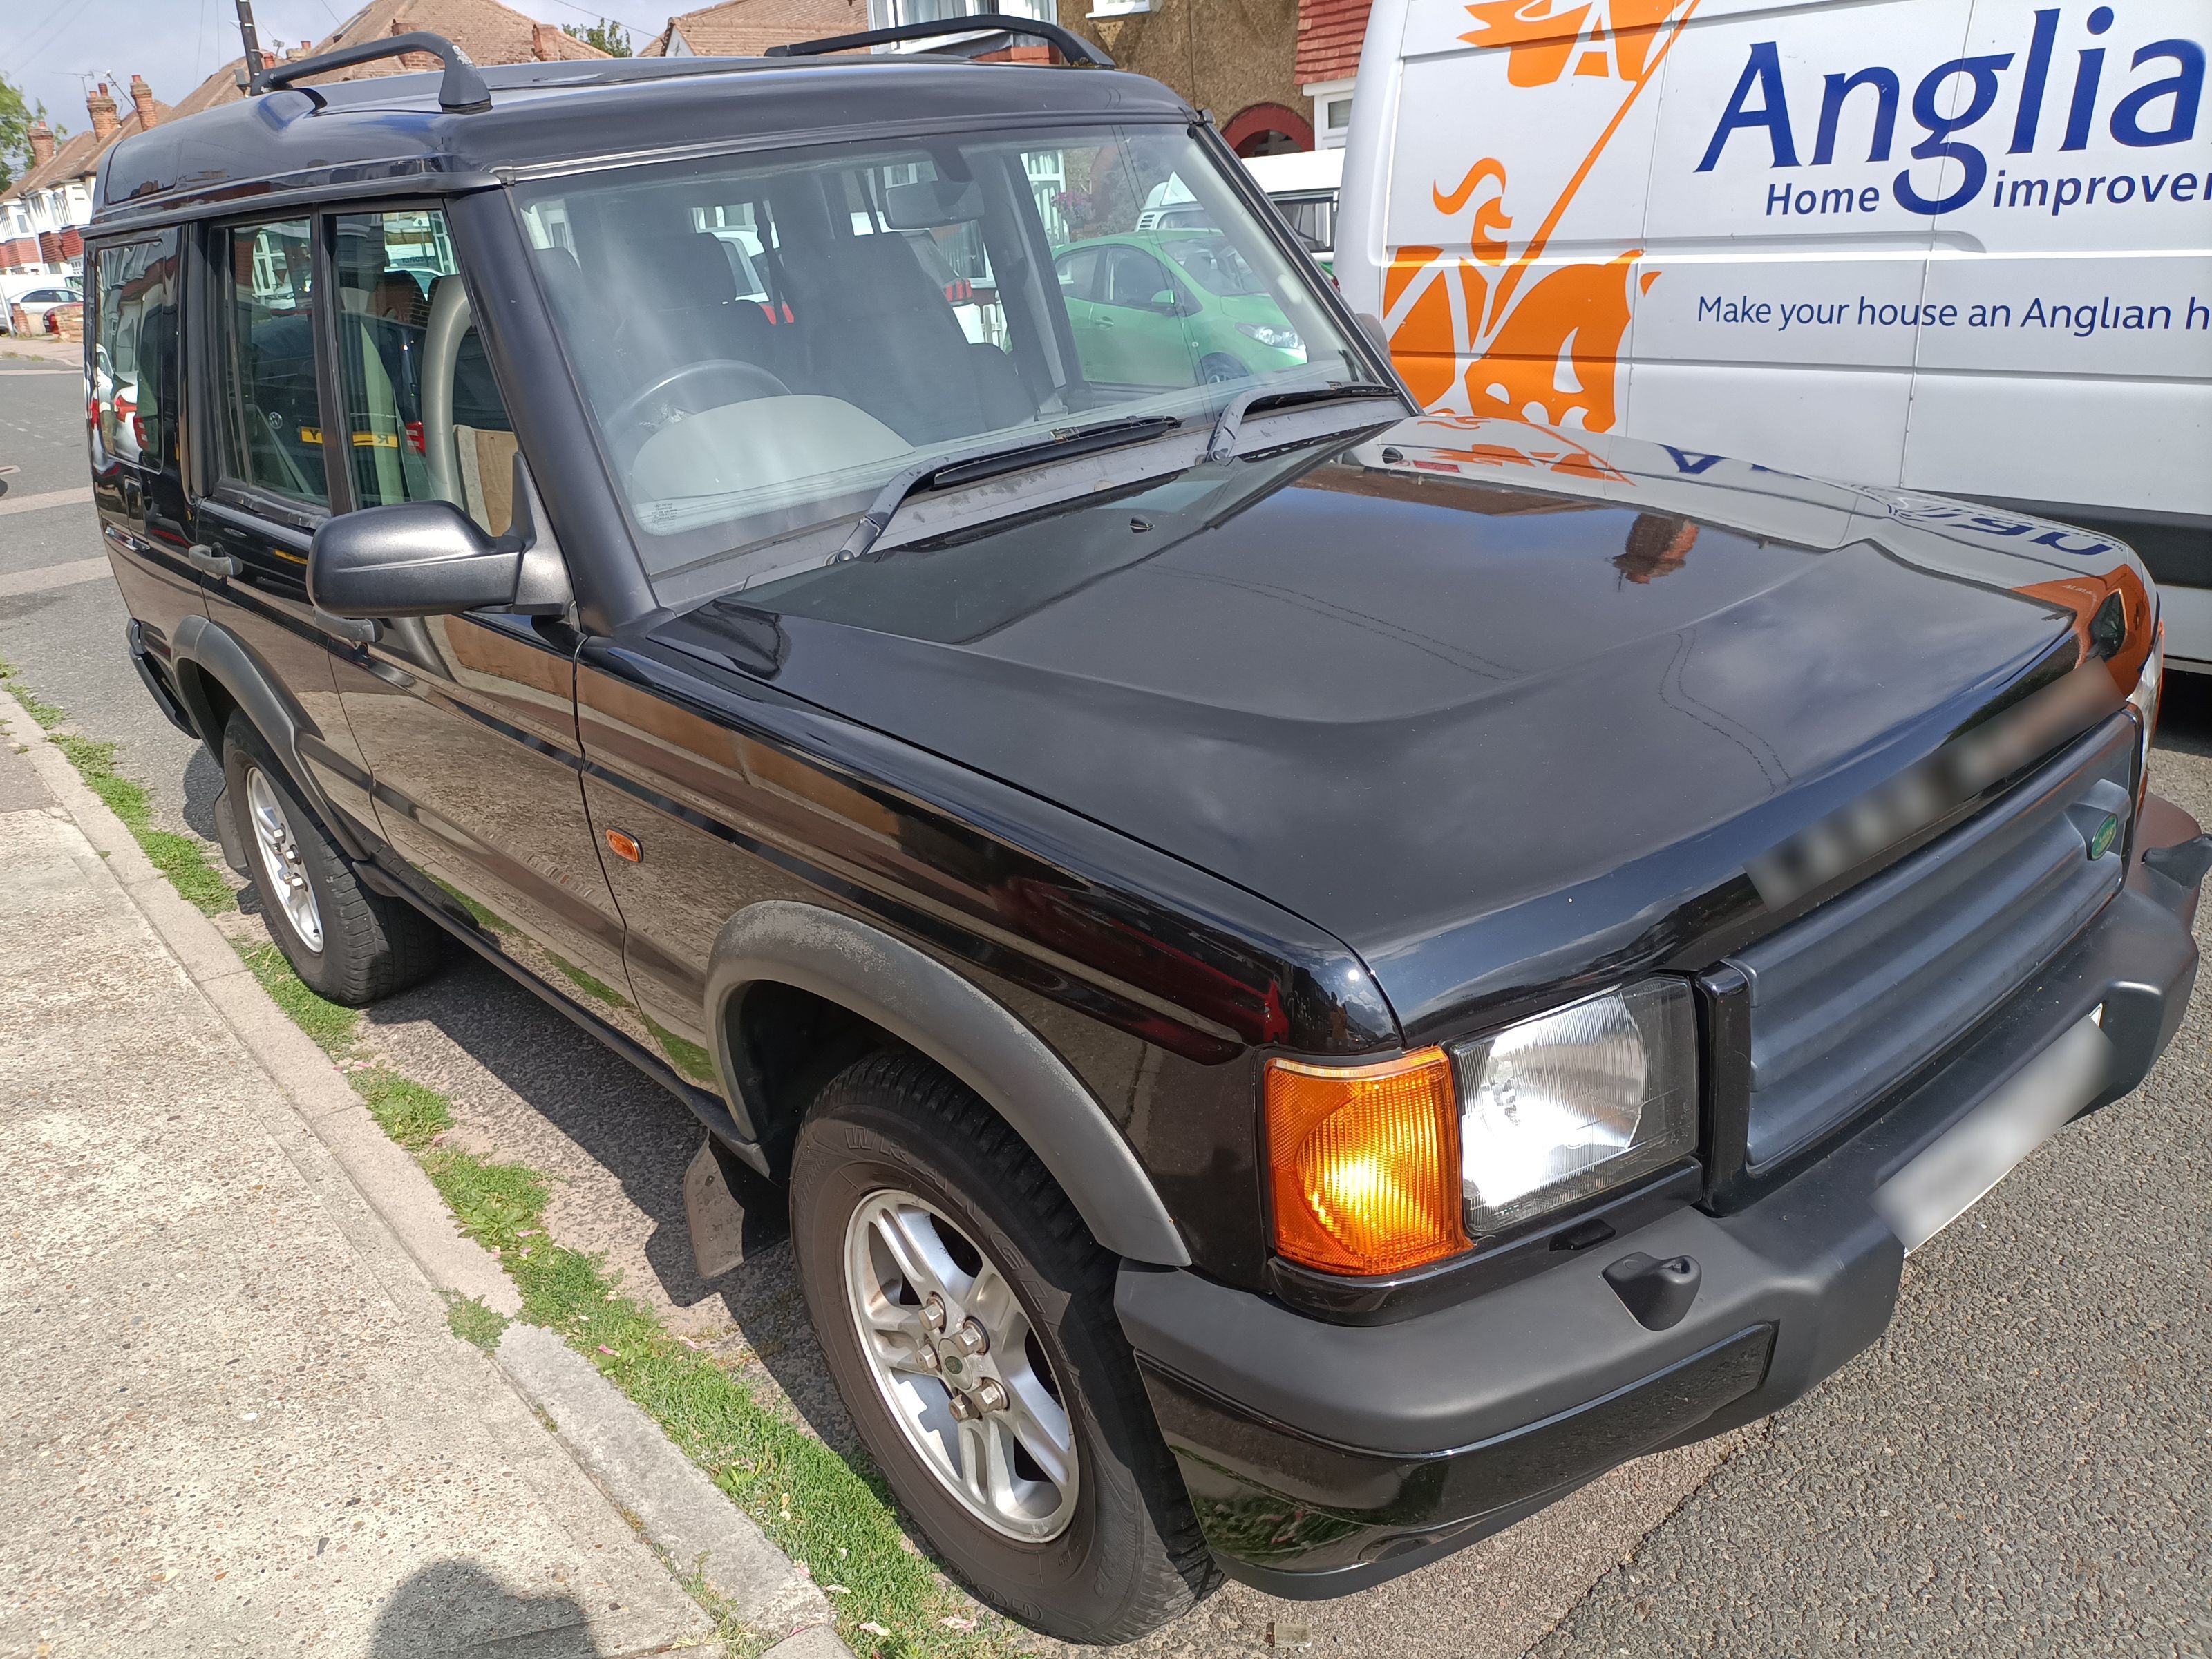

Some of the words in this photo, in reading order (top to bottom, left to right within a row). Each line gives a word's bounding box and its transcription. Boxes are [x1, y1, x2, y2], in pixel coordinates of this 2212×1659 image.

[1693, 6, 2206, 216] Anglia
[1765, 182, 1880, 216] Home
[1992, 169, 2212, 216] improve
[1697, 296, 1772, 324] Make
[1778, 303, 1850, 332] your
[1857, 296, 1958, 327] house
[1967, 304, 2012, 328] an
[2019, 297, 2172, 338] Anglian
